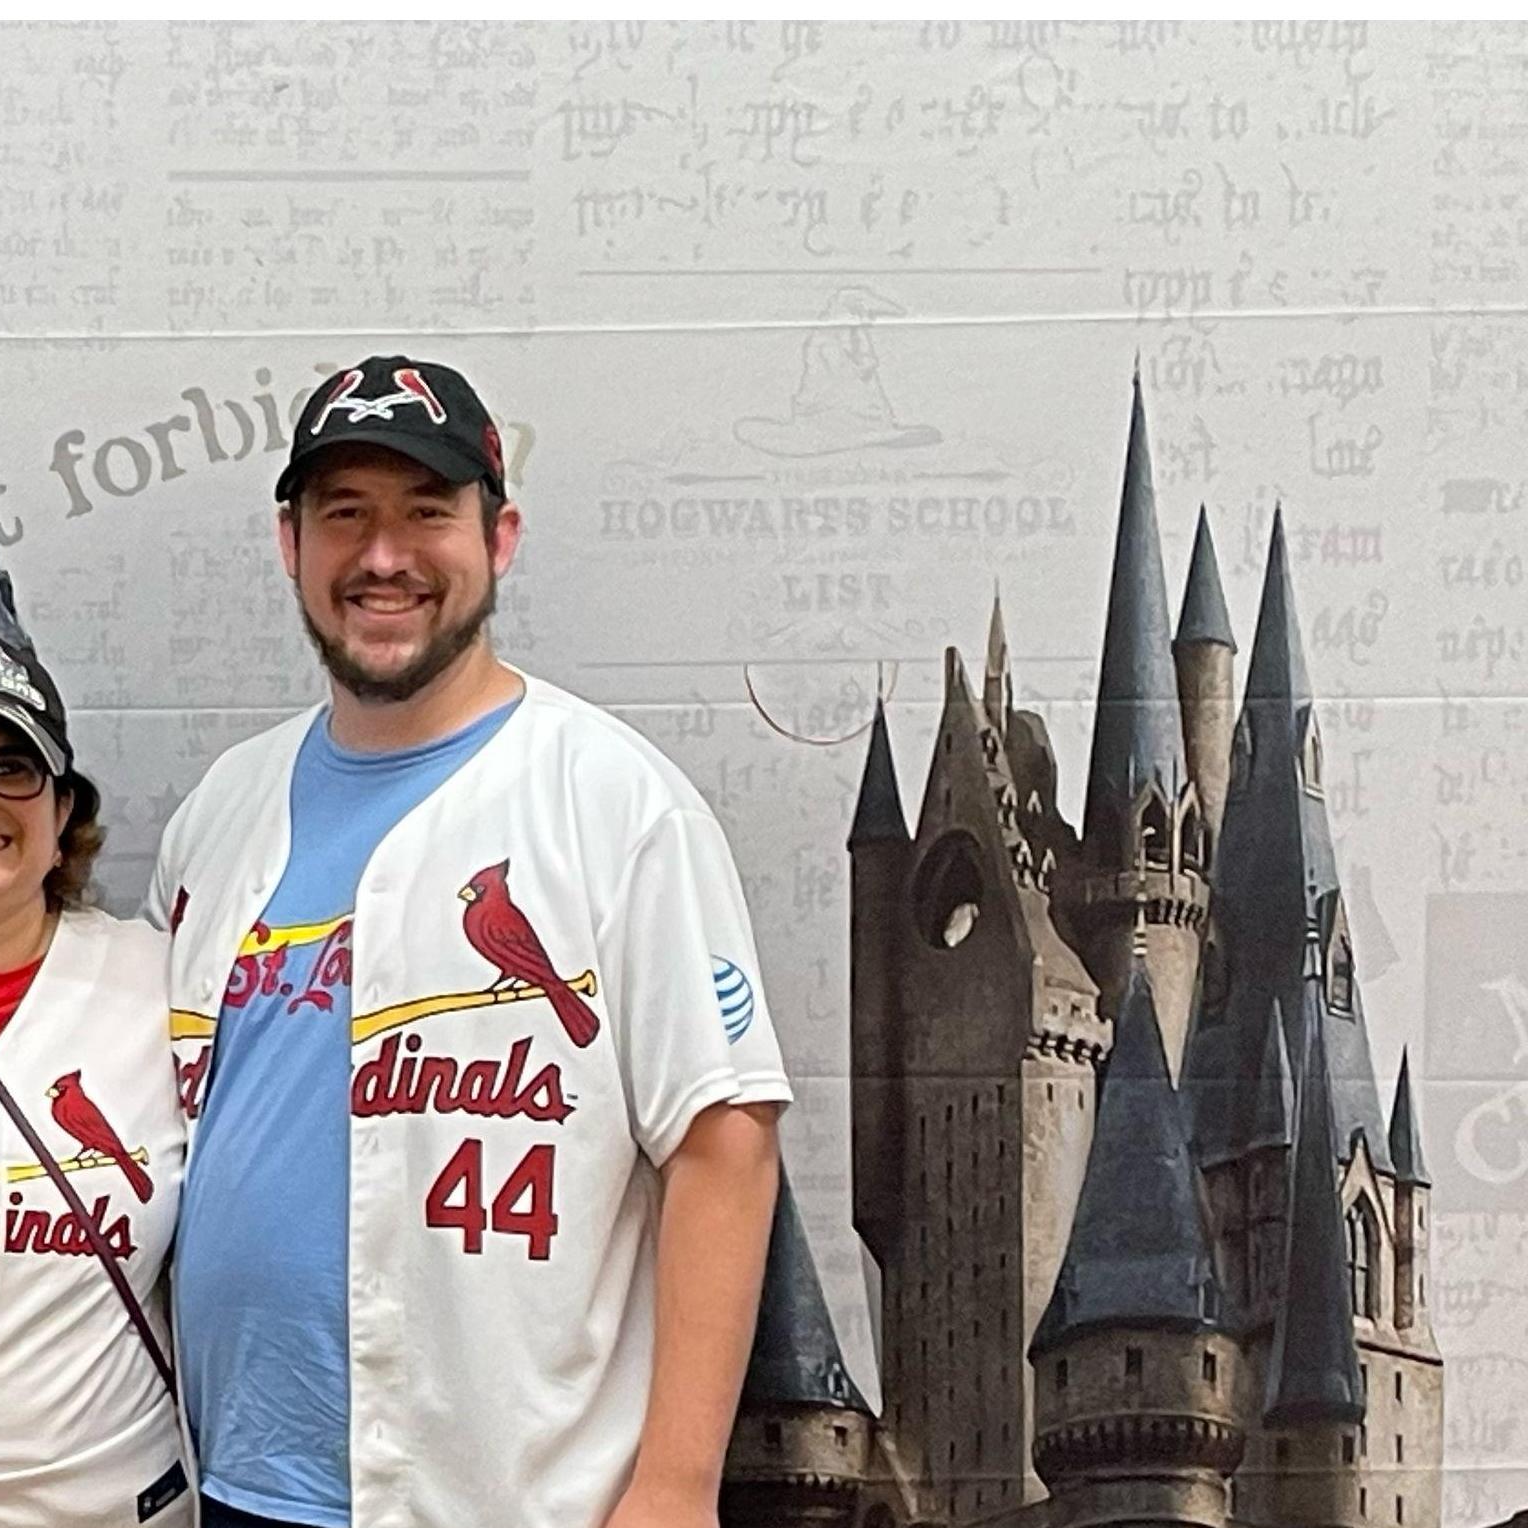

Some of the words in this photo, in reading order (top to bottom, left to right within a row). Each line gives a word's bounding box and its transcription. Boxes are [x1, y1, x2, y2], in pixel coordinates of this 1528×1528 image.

[599, 496, 871, 541] HOGWARTS
[887, 495, 1077, 538] SCHOOL
[781, 573, 891, 612] LIST
[352, 1031, 577, 1126] dinals
[426, 1137, 558, 1261] 44
